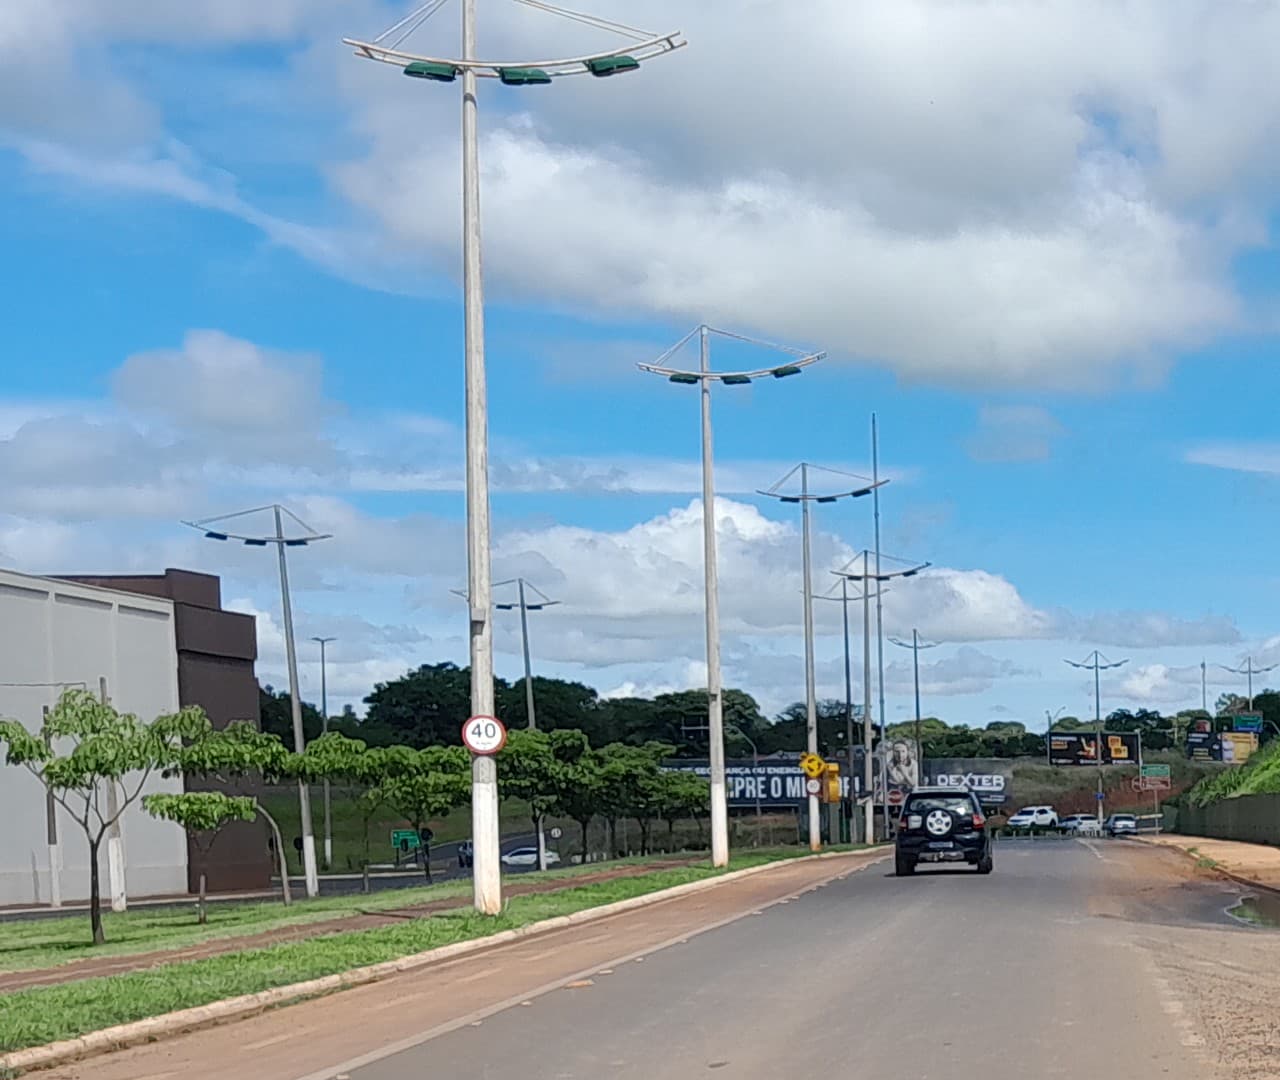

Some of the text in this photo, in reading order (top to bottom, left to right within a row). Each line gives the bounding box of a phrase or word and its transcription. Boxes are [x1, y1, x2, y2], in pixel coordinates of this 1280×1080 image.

[471, 722, 496, 738] 40
[770, 776, 782, 798] O
[937, 772, 1005, 791] DEXTER
